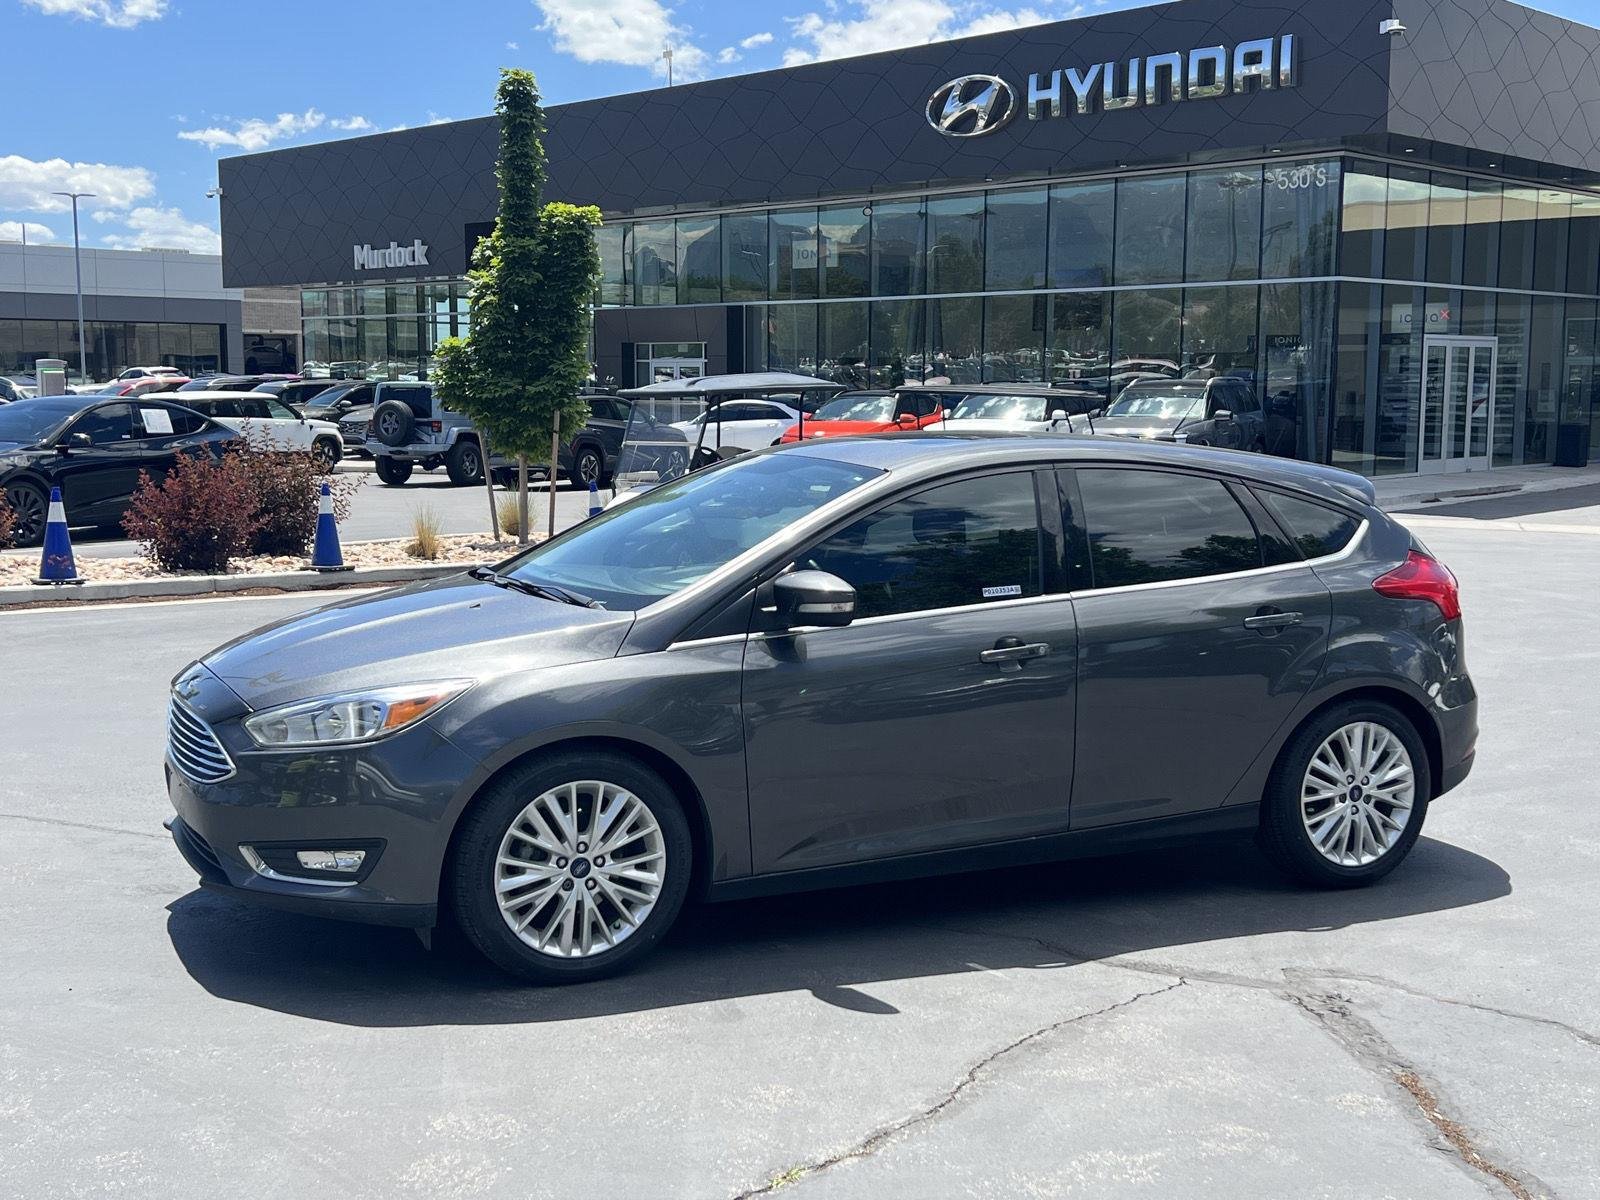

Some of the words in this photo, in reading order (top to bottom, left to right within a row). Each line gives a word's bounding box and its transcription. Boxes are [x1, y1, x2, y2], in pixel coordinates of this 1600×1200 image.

[1028, 34, 1298, 120] HYUNDAI
[1277, 170, 1311, 189] 530
[1315, 167, 1327, 187] S
[353, 239, 430, 270] Murdock
